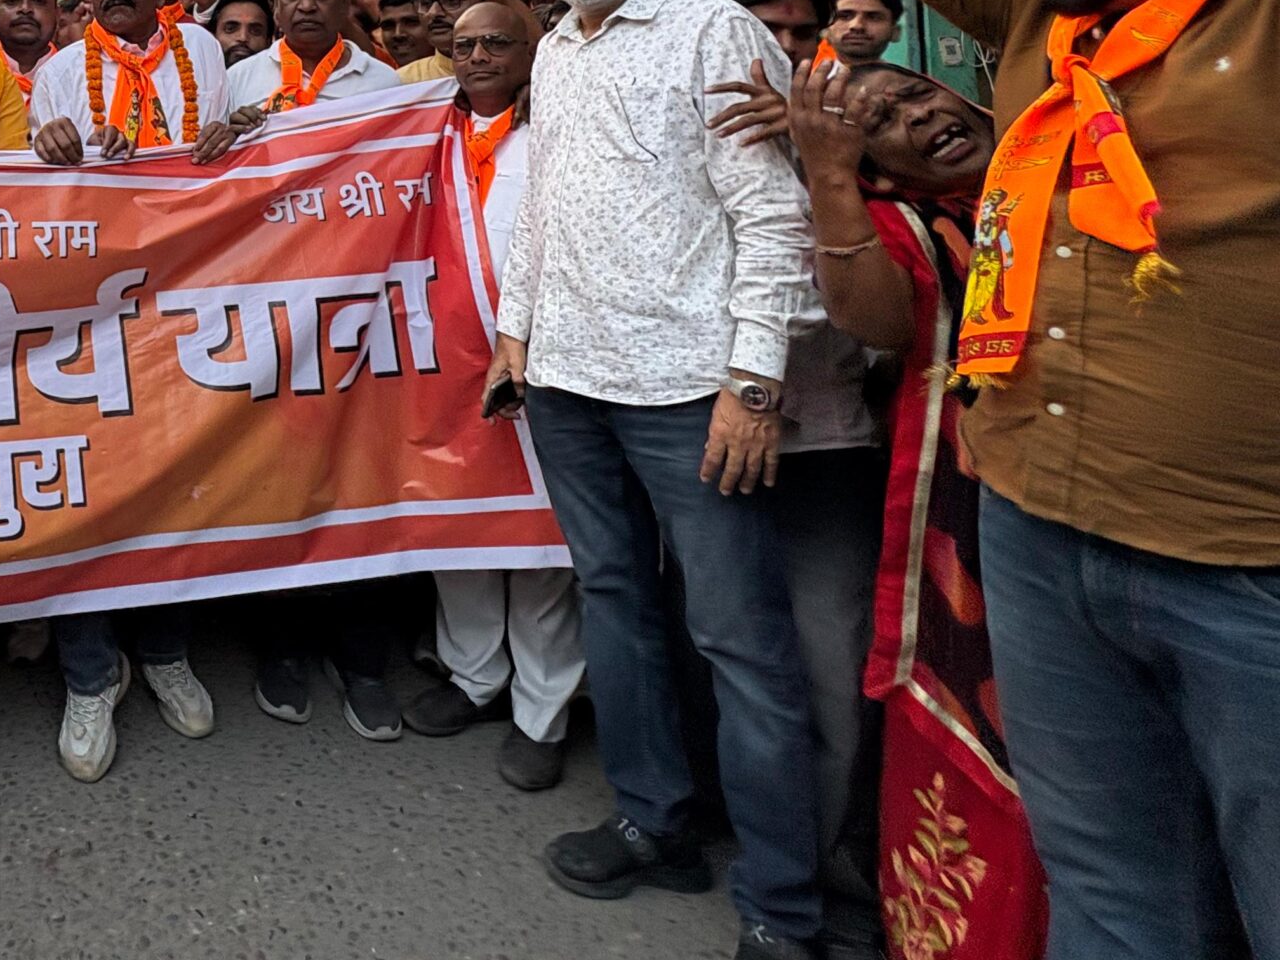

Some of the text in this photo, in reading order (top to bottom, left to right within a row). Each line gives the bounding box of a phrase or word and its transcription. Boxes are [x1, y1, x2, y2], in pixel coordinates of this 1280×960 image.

[263, 187, 327, 224] जय
[338, 171, 386, 218] श्री
[31, 220, 99, 258] राम
[155, 256, 441, 402] यात्रा
